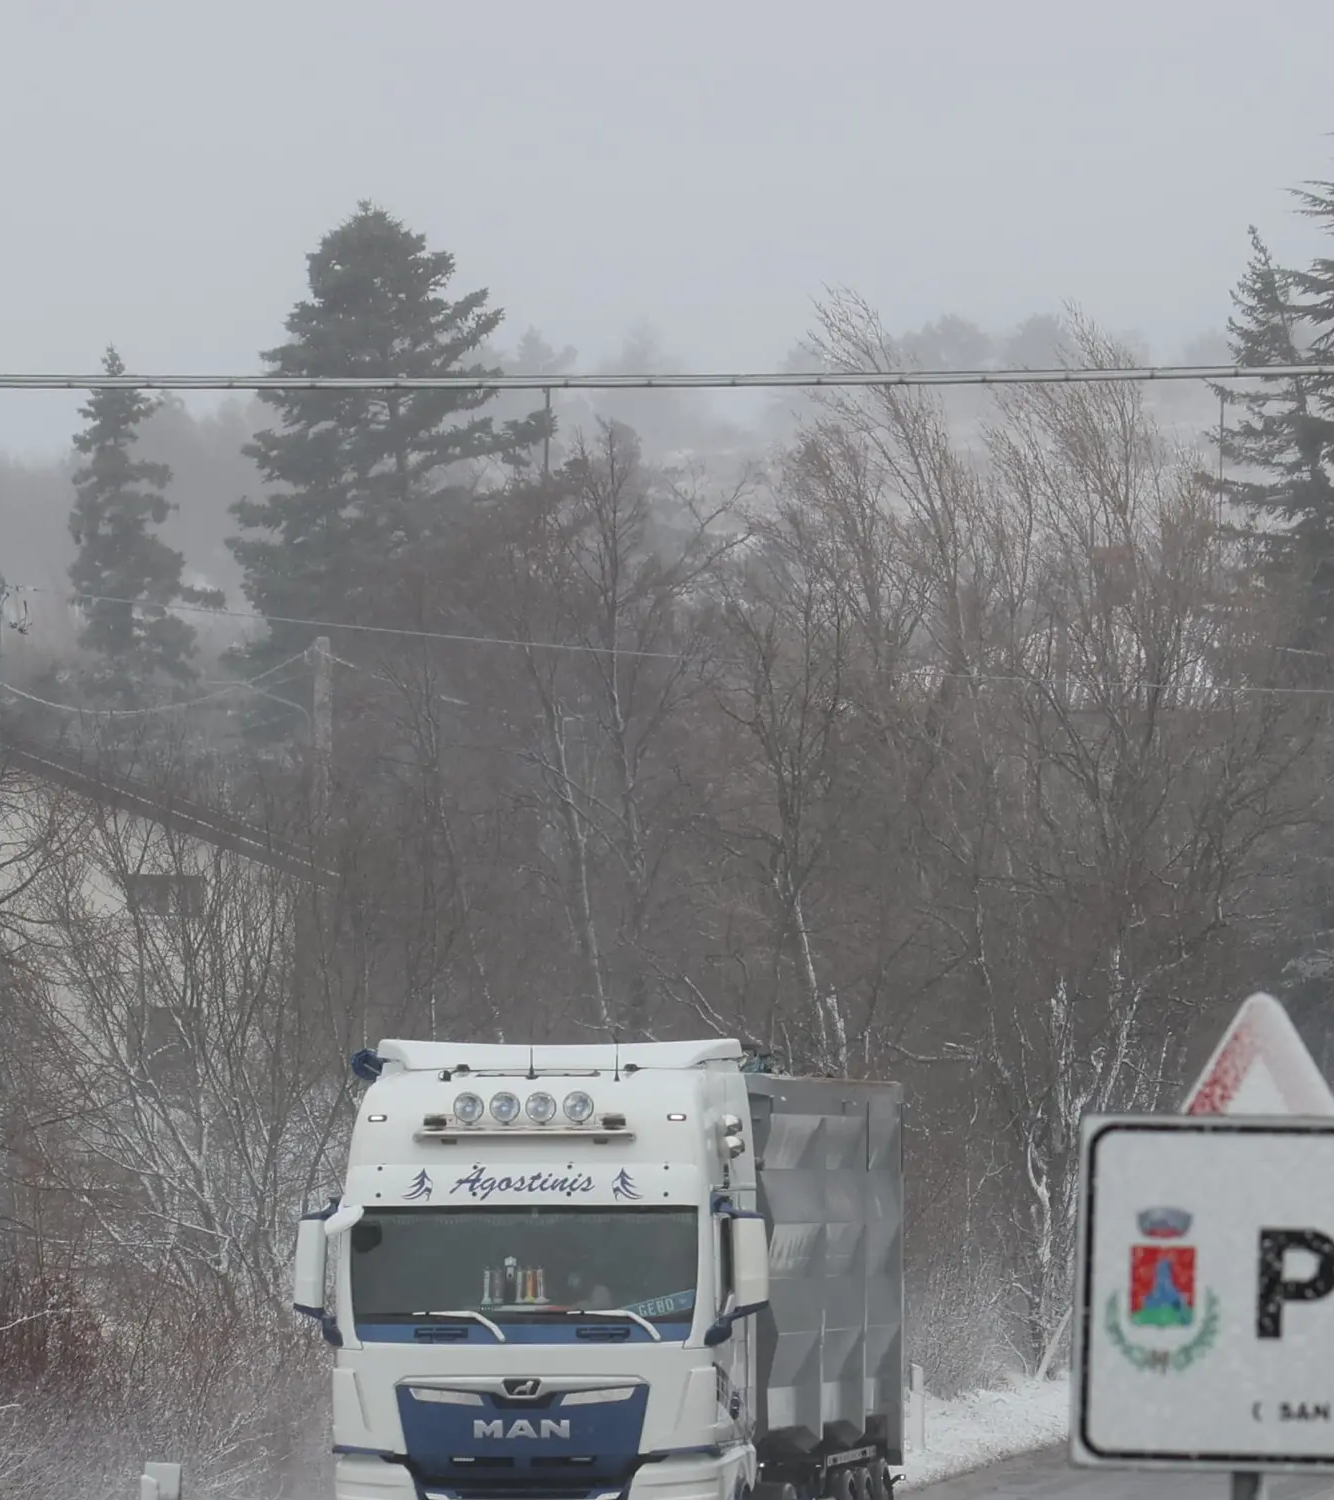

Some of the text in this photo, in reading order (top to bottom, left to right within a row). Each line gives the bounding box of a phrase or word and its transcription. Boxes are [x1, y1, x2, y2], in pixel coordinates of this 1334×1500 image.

[450, 1166, 596, 1201] Agostinis
[1279, 1402, 1331, 1424] SAN
[473, 1419, 570, 1439] MAN
